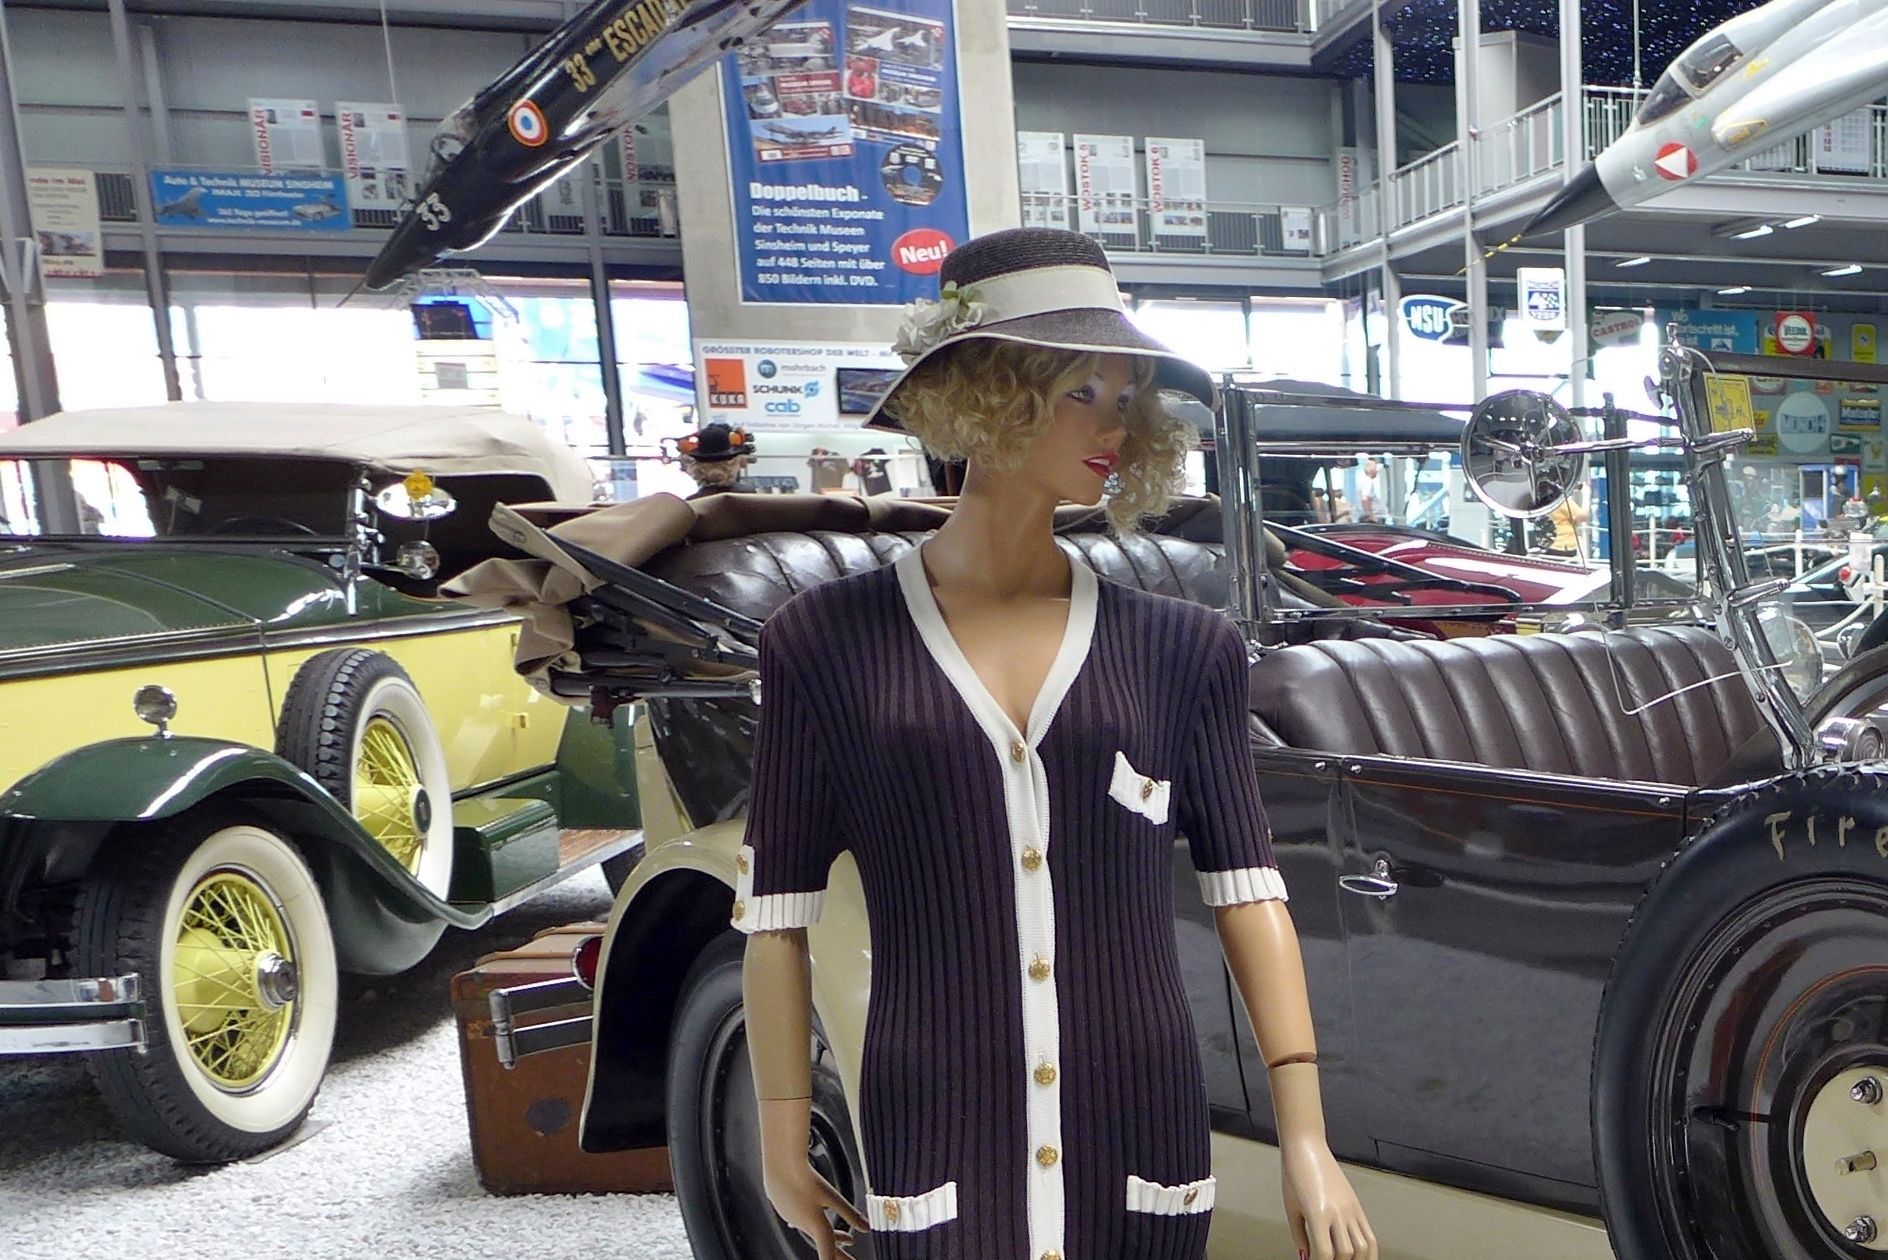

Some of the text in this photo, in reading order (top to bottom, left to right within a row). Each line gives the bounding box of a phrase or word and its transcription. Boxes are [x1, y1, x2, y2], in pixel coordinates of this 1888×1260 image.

[564, 52, 596, 93] 33
[163, 175, 188, 187] Auto
[200, 176, 239, 188] Technik
[240, 177, 284, 189] MUSEUM
[286, 178, 334, 190] SINSHEIM
[750, 182, 860, 203] Doppelbuch
[416, 192, 451, 231] 33
[752, 205, 885, 221] Die schönsten Exponate
[753, 222, 865, 236] der Technik Museen
[754, 239, 871, 254] Sinsheim und Speyer
[900, 240, 950, 265] Neu!
[756, 257, 776, 268] auf
[800, 257, 836, 269] Seiten
[838, 258, 857, 270] mit
[859, 258, 886, 270] über
[781, 273, 822, 285] Bildern
[823, 274, 848, 286] inkl.
[850, 275, 879, 287] DVD.
[1411, 304, 1445, 334] NSU
[753, 346, 824, 356] ROBOTERSHOP
[826, 348, 844, 357] DER
[847, 348, 870, 357] WELT
[752, 384, 804, 394] SCHUNK
[710, 392, 746, 406] KUKA
[764, 398, 802, 414] cab
